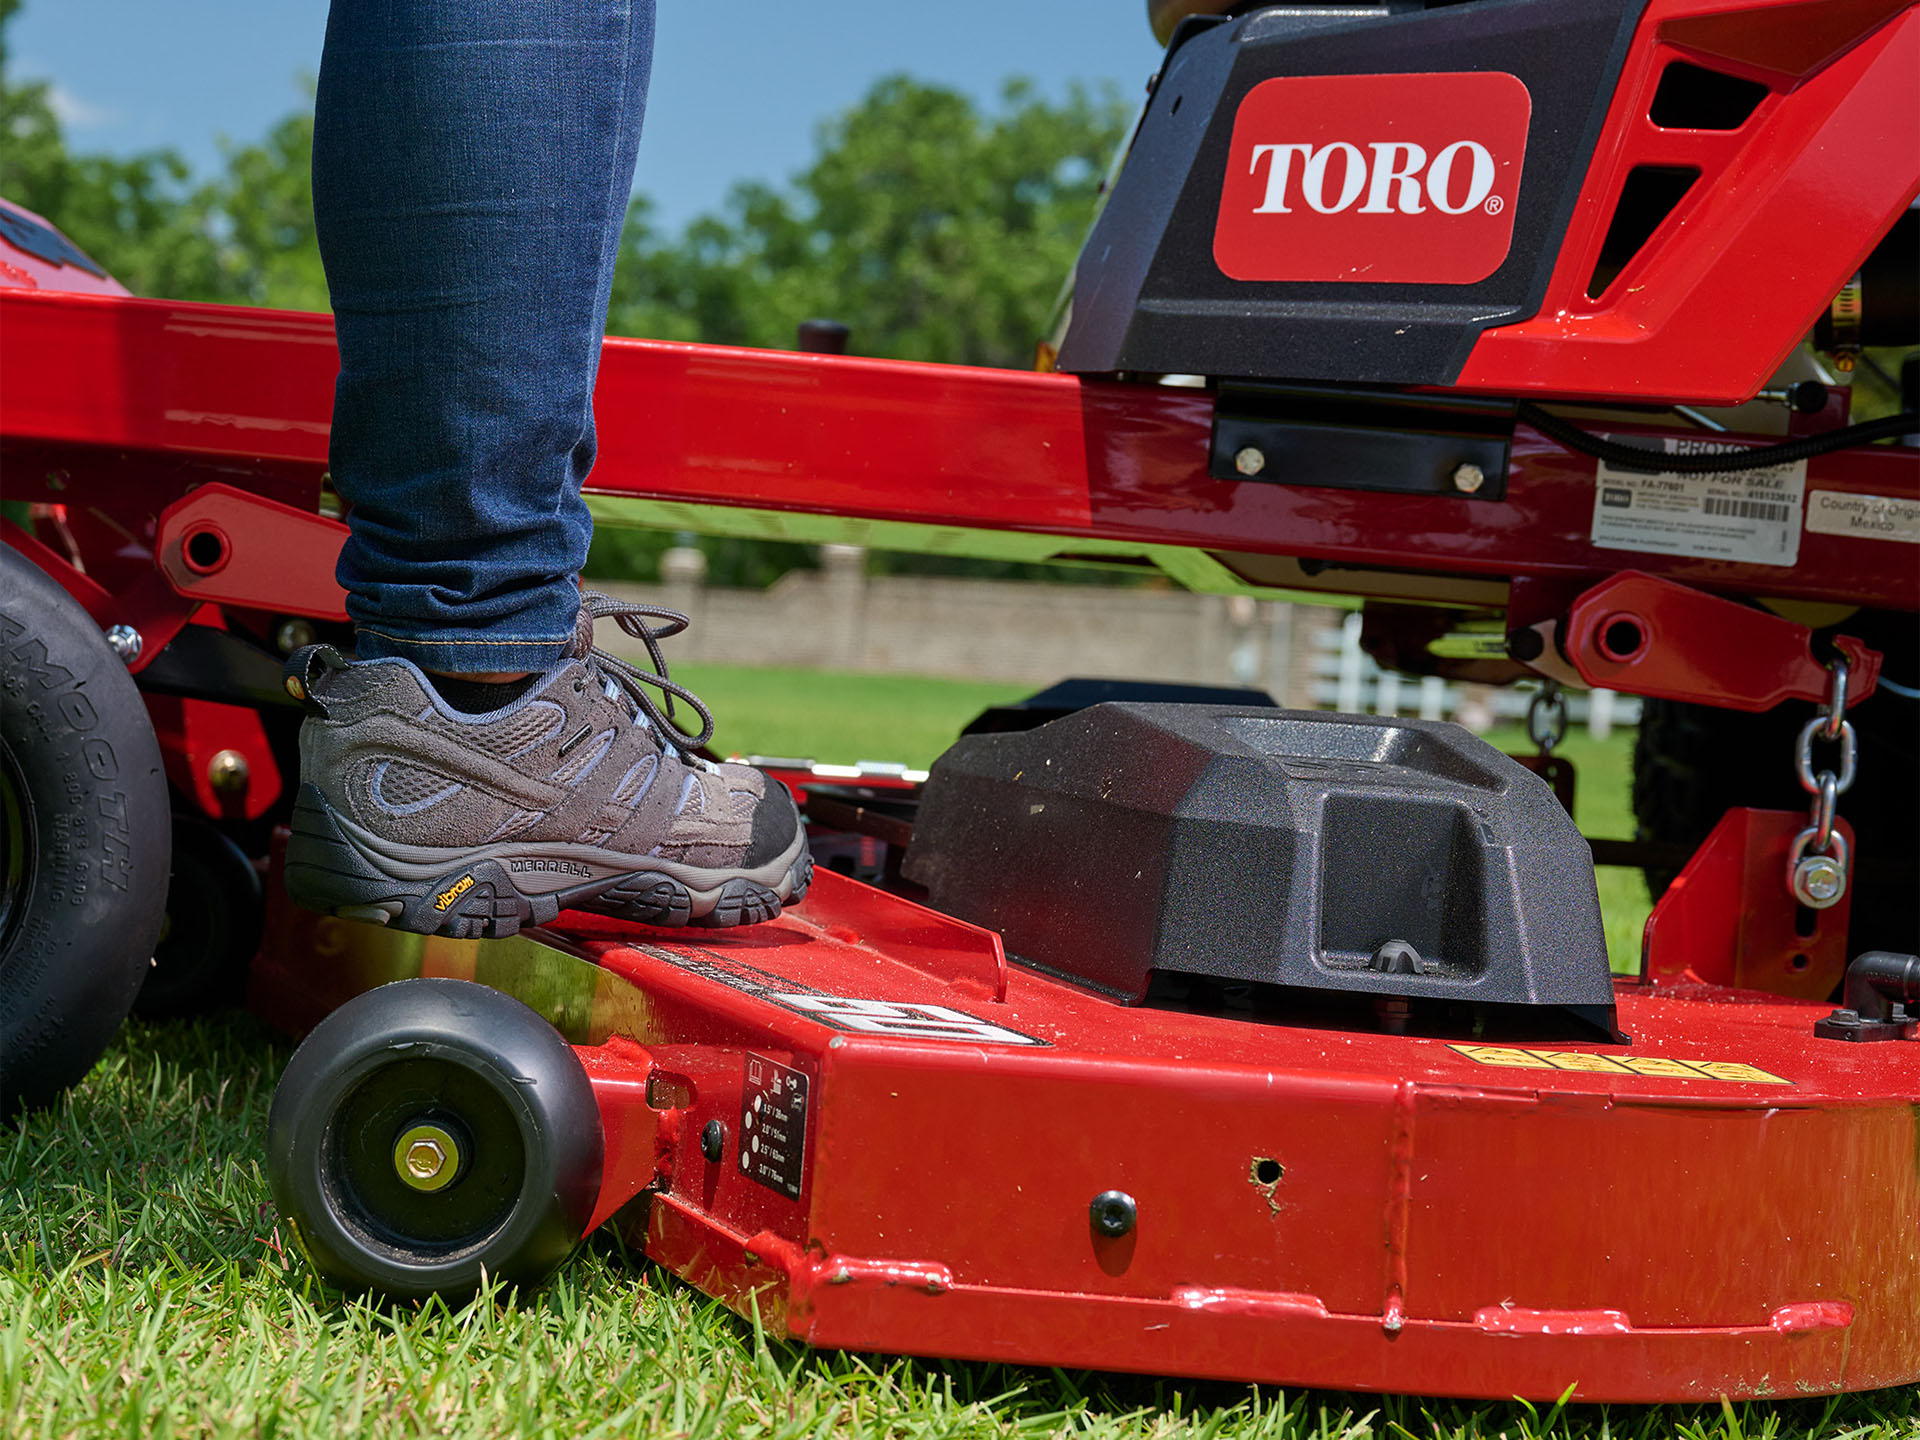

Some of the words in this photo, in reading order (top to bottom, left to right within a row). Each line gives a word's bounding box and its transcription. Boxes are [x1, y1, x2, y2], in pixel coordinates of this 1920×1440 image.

[1249, 140, 1496, 215] TORO
[1711, 473, 1741, 485] FOR
[1746, 477, 1784, 489] SALE
[1820, 496, 1869, 514] Country
[1872, 503, 1885, 514] of
[1850, 515, 1895, 532] Mexico
[511, 860, 592, 879] MERRELL
[434, 875, 475, 911] vibram
